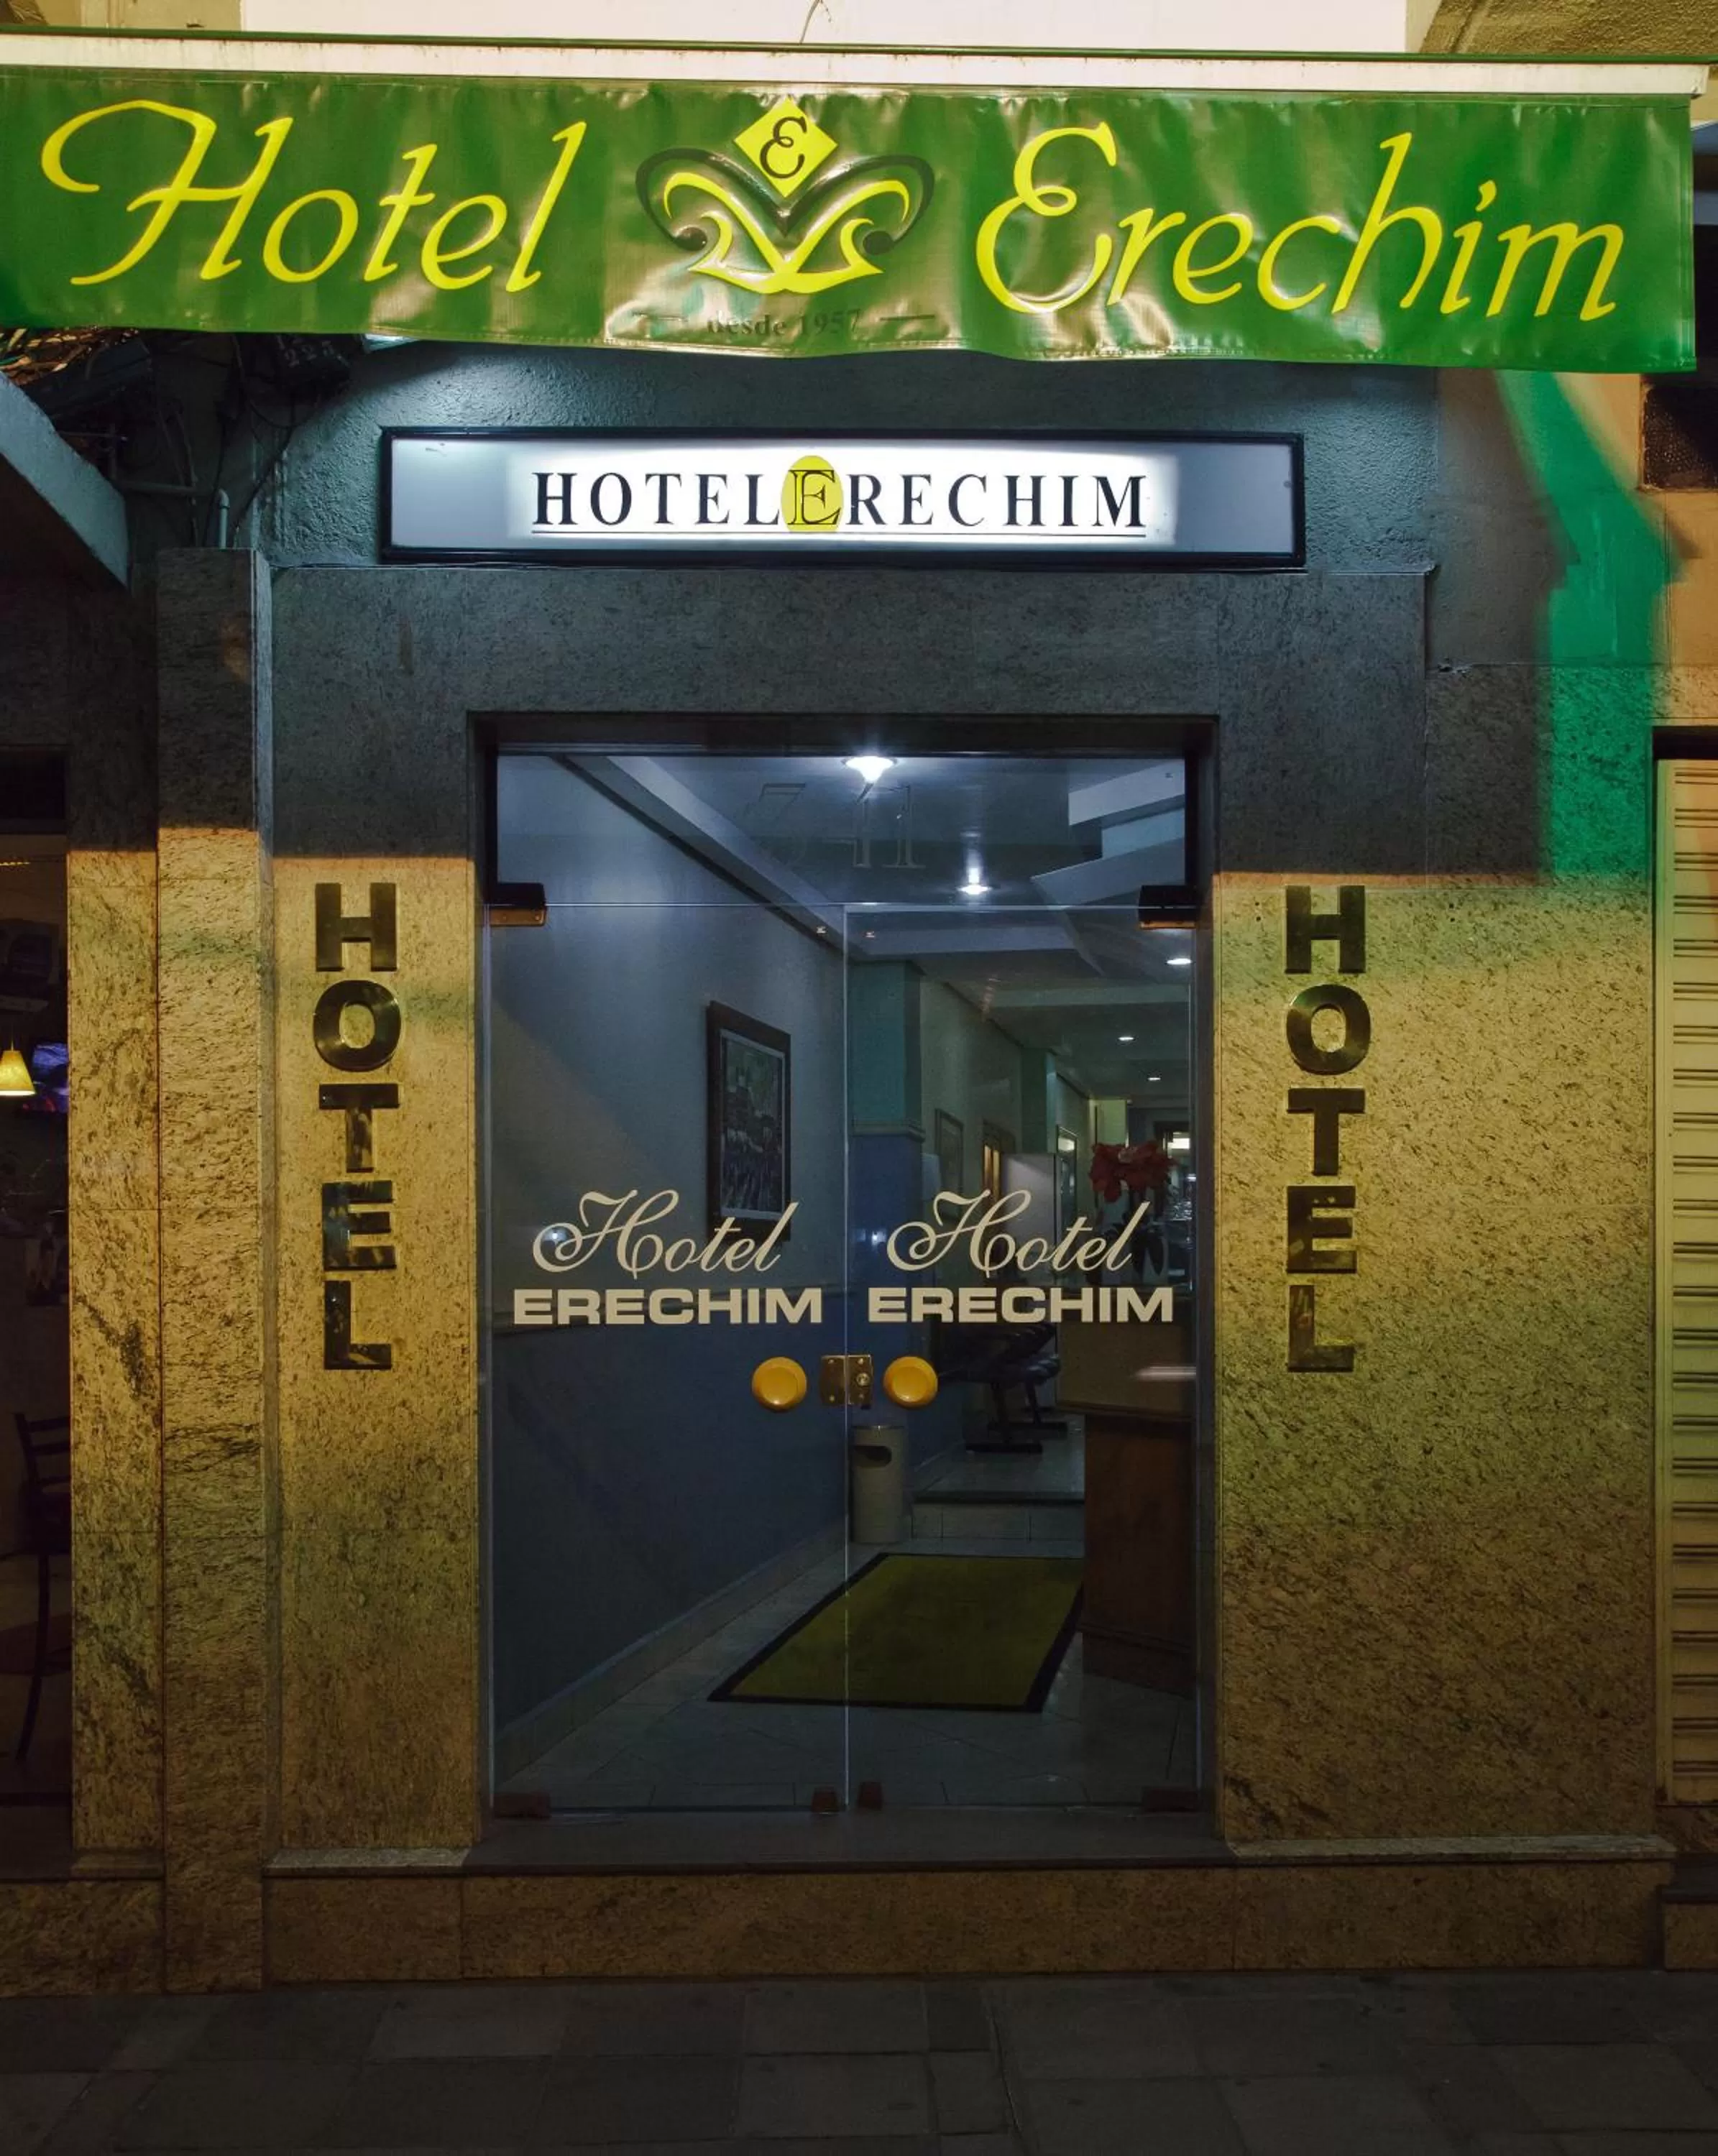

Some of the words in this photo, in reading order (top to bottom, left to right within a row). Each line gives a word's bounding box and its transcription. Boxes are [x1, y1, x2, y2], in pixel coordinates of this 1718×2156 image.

[759, 116, 808, 179] E
[41, 99, 587, 292] Hotel
[975, 121, 1624, 321] Erechim
[707, 313, 786, 337] desde
[799, 308, 862, 336] 1957
[313, 883, 402, 1370] HOTEL
[1285, 885, 1372, 1373] HOTEL
[532, 1189, 799, 1280] Hotel
[886, 1188, 1151, 1279] Hotel
[513, 1288, 823, 1325] ERECHIM
[868, 1286, 1175, 1324] ERECHIM
